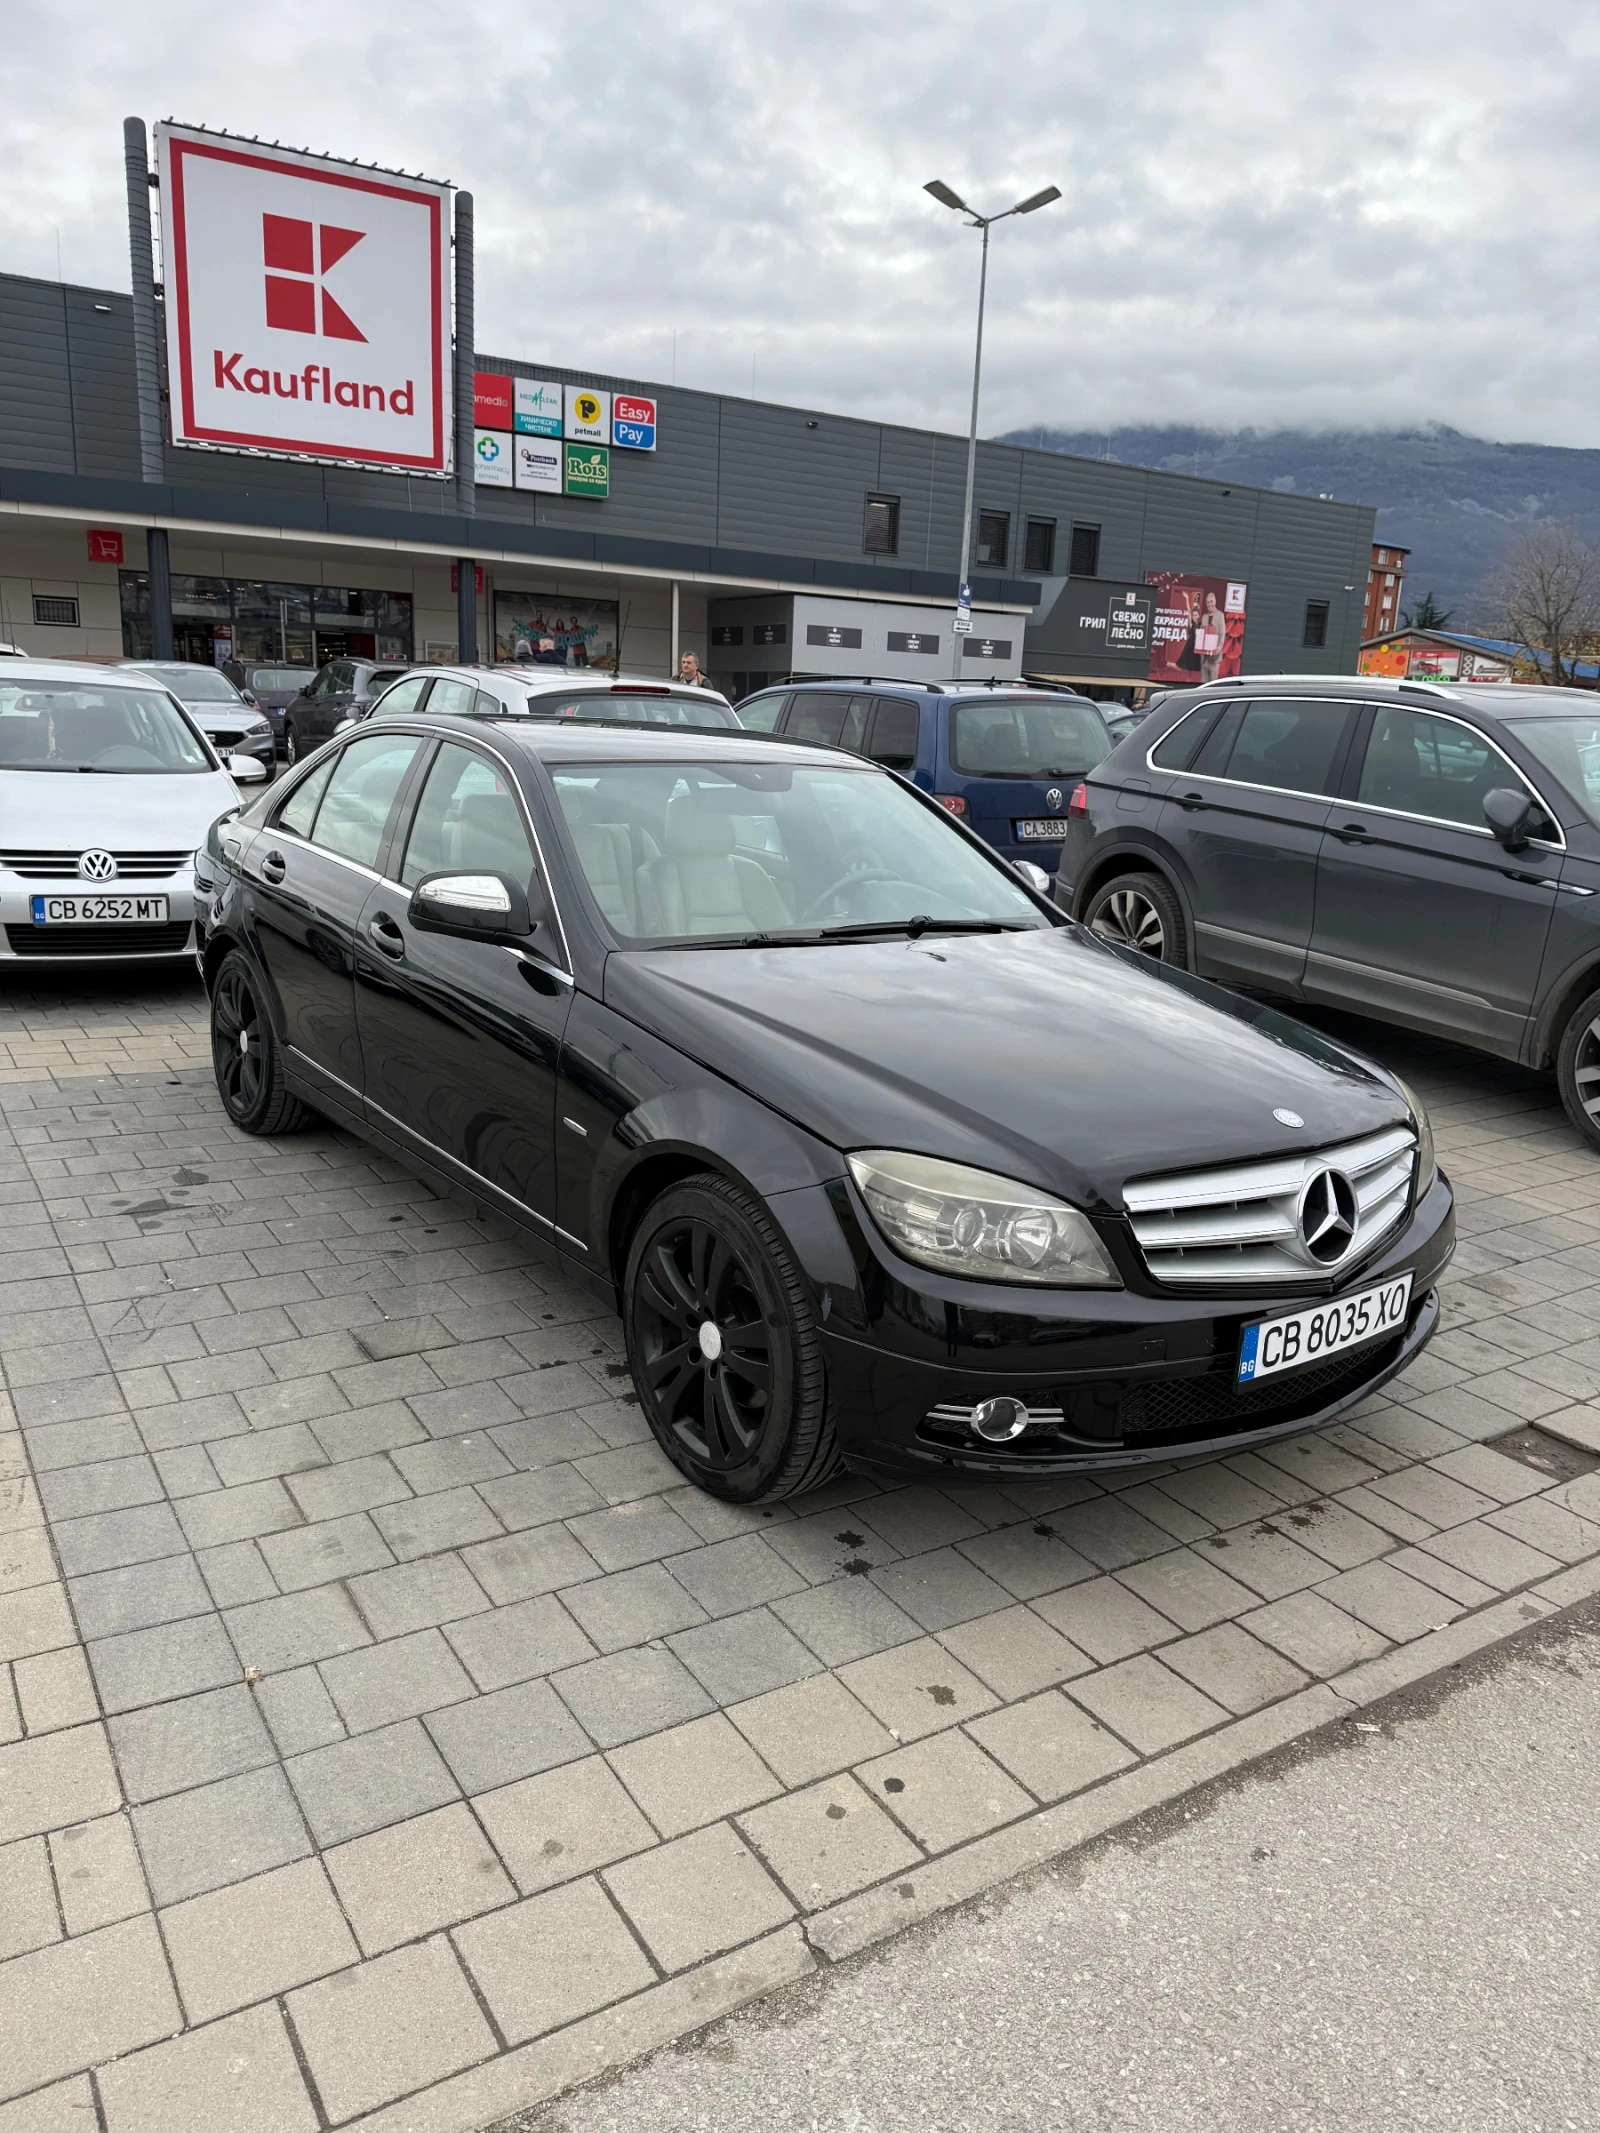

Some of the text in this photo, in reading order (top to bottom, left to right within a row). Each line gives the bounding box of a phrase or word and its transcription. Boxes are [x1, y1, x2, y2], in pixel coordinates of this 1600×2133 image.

[213, 349, 414, 416] Kaufland
[619, 402, 651, 424] Easy
[520, 415, 558, 427] ХИМИЧЕСКО
[524, 423, 553, 434] ЧИСТЕНЕ
[574, 427, 602, 438] petmall
[619, 424, 644, 444] Pay
[568, 457, 607, 479] Rois
[1079, 616, 1106, 629] ГРИЛ
[1112, 610, 1146, 624] СВЕЖО
[1110, 626, 1144, 640] ЛЕСНО
[35, 912, 45, 920] BG
[48, 899, 163, 920] CB 6252 MT
[1262, 1283, 1406, 1368] CB 8035 XO
[1240, 1359, 1255, 1375] BG
